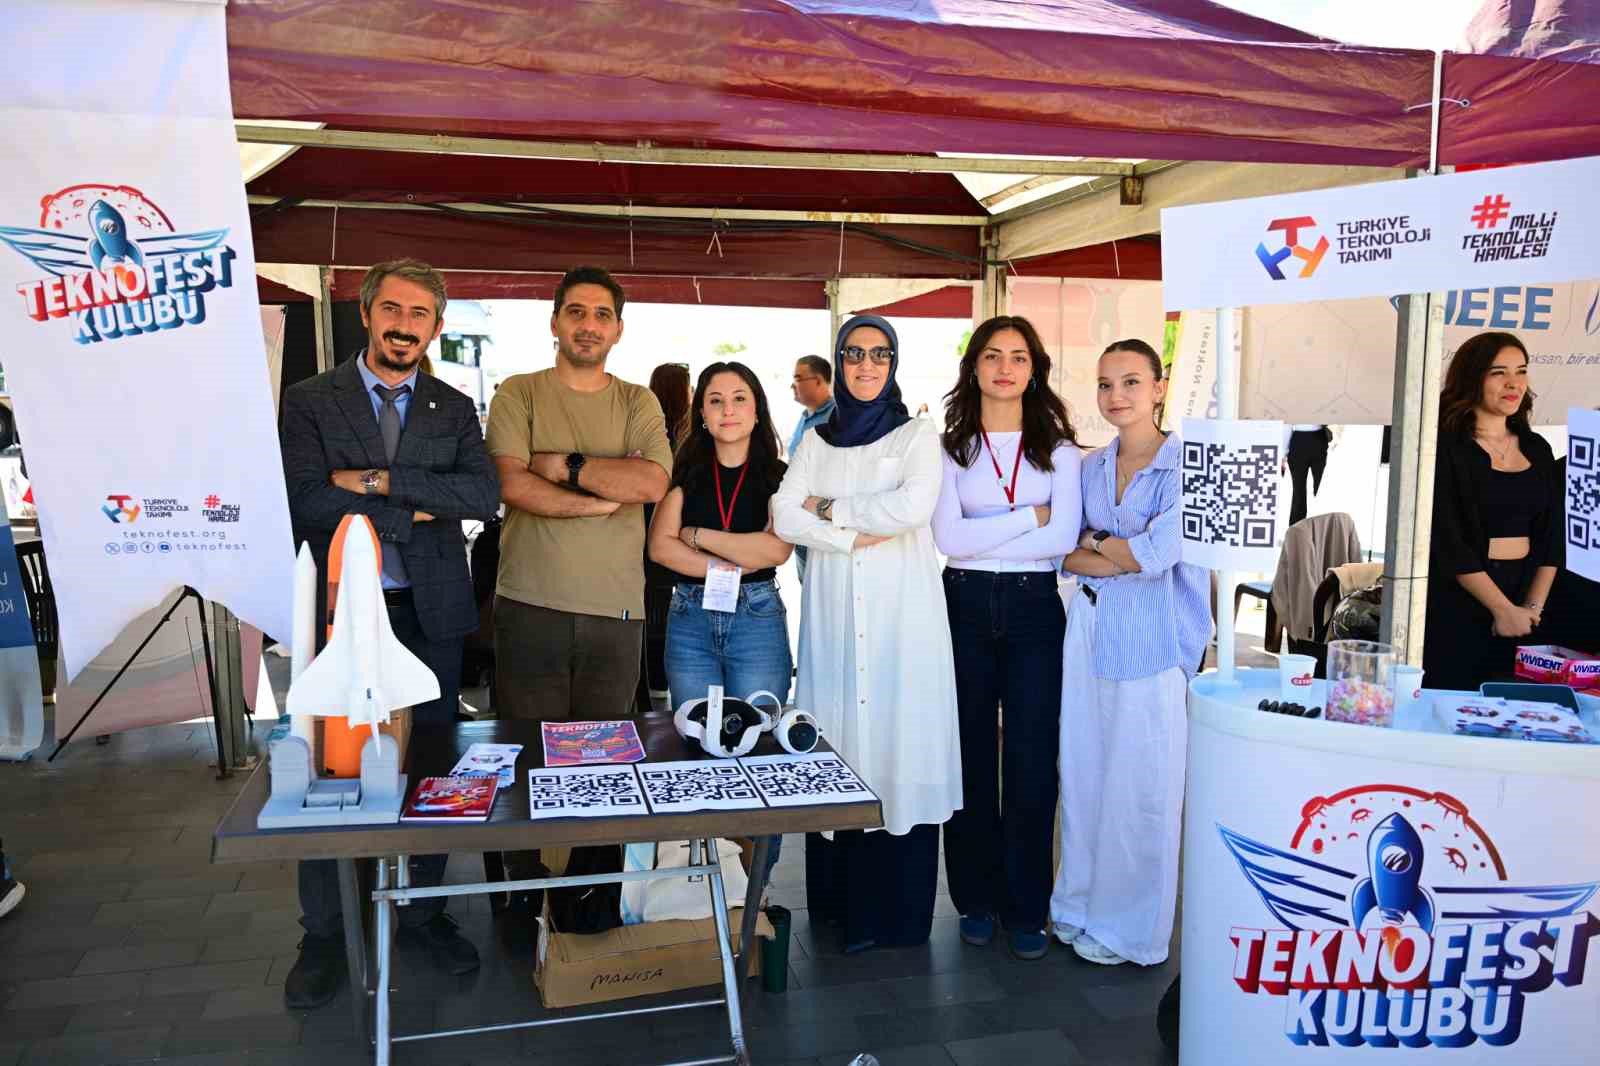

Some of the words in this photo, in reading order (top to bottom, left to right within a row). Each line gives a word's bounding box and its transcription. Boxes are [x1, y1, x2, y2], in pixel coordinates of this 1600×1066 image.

[1336, 248, 1392, 264] TAKIMI
[16, 245, 236, 321] TEKNOFEST
[1529, 355, 1565, 367] oksan,
[122, 529, 226, 539] teknofest.org
[176, 542, 248, 551] teknofest
[1574, 664, 1600, 673] VIVIDE
[1229, 911, 1600, 995] TEKNOFEST
